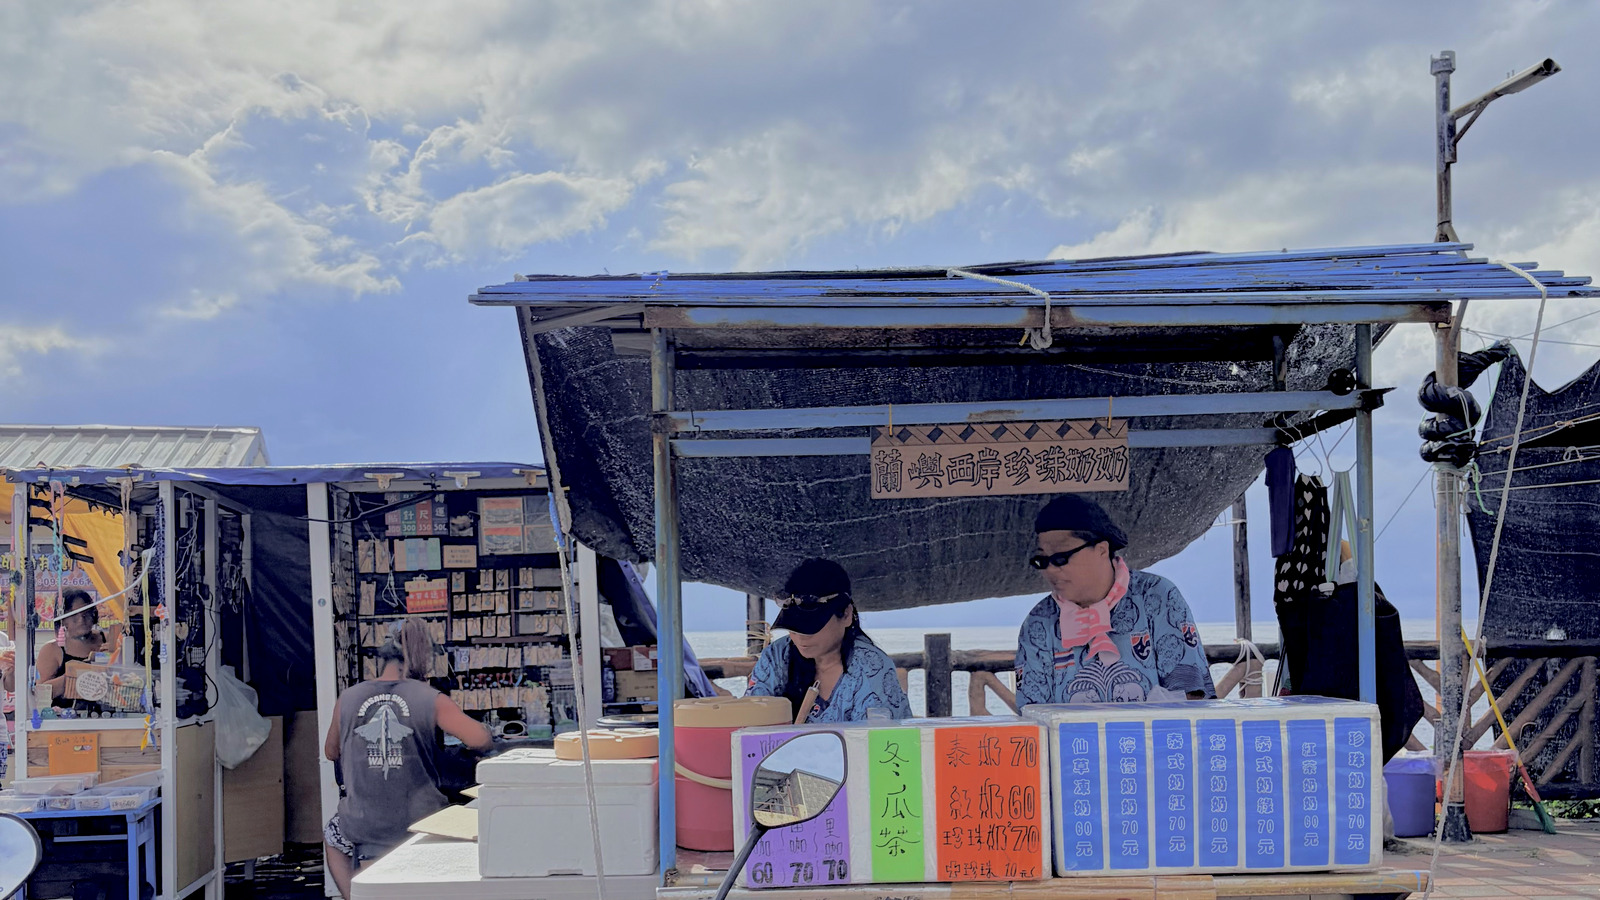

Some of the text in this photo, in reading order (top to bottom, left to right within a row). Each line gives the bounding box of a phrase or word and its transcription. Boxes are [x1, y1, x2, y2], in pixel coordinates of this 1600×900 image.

[874, 445, 1129, 493] 蘭嶼西岸珍珠奶奶
[391, 694, 411, 716] SHOW
[1010, 737, 1038, 767] 70
[876, 740, 921, 857] 冬瓜茶
[950, 778, 1035, 820] 紅奶 60
[1166, 732, 1186, 853] 泰式奶紅70元
[1348, 731, 1365, 850] 珍珠奶奶70元
[1011, 825, 1039, 853] 70
[752, 861, 774, 884] 60
[789, 861, 813, 883] 70
[823, 859, 848, 880] 70
